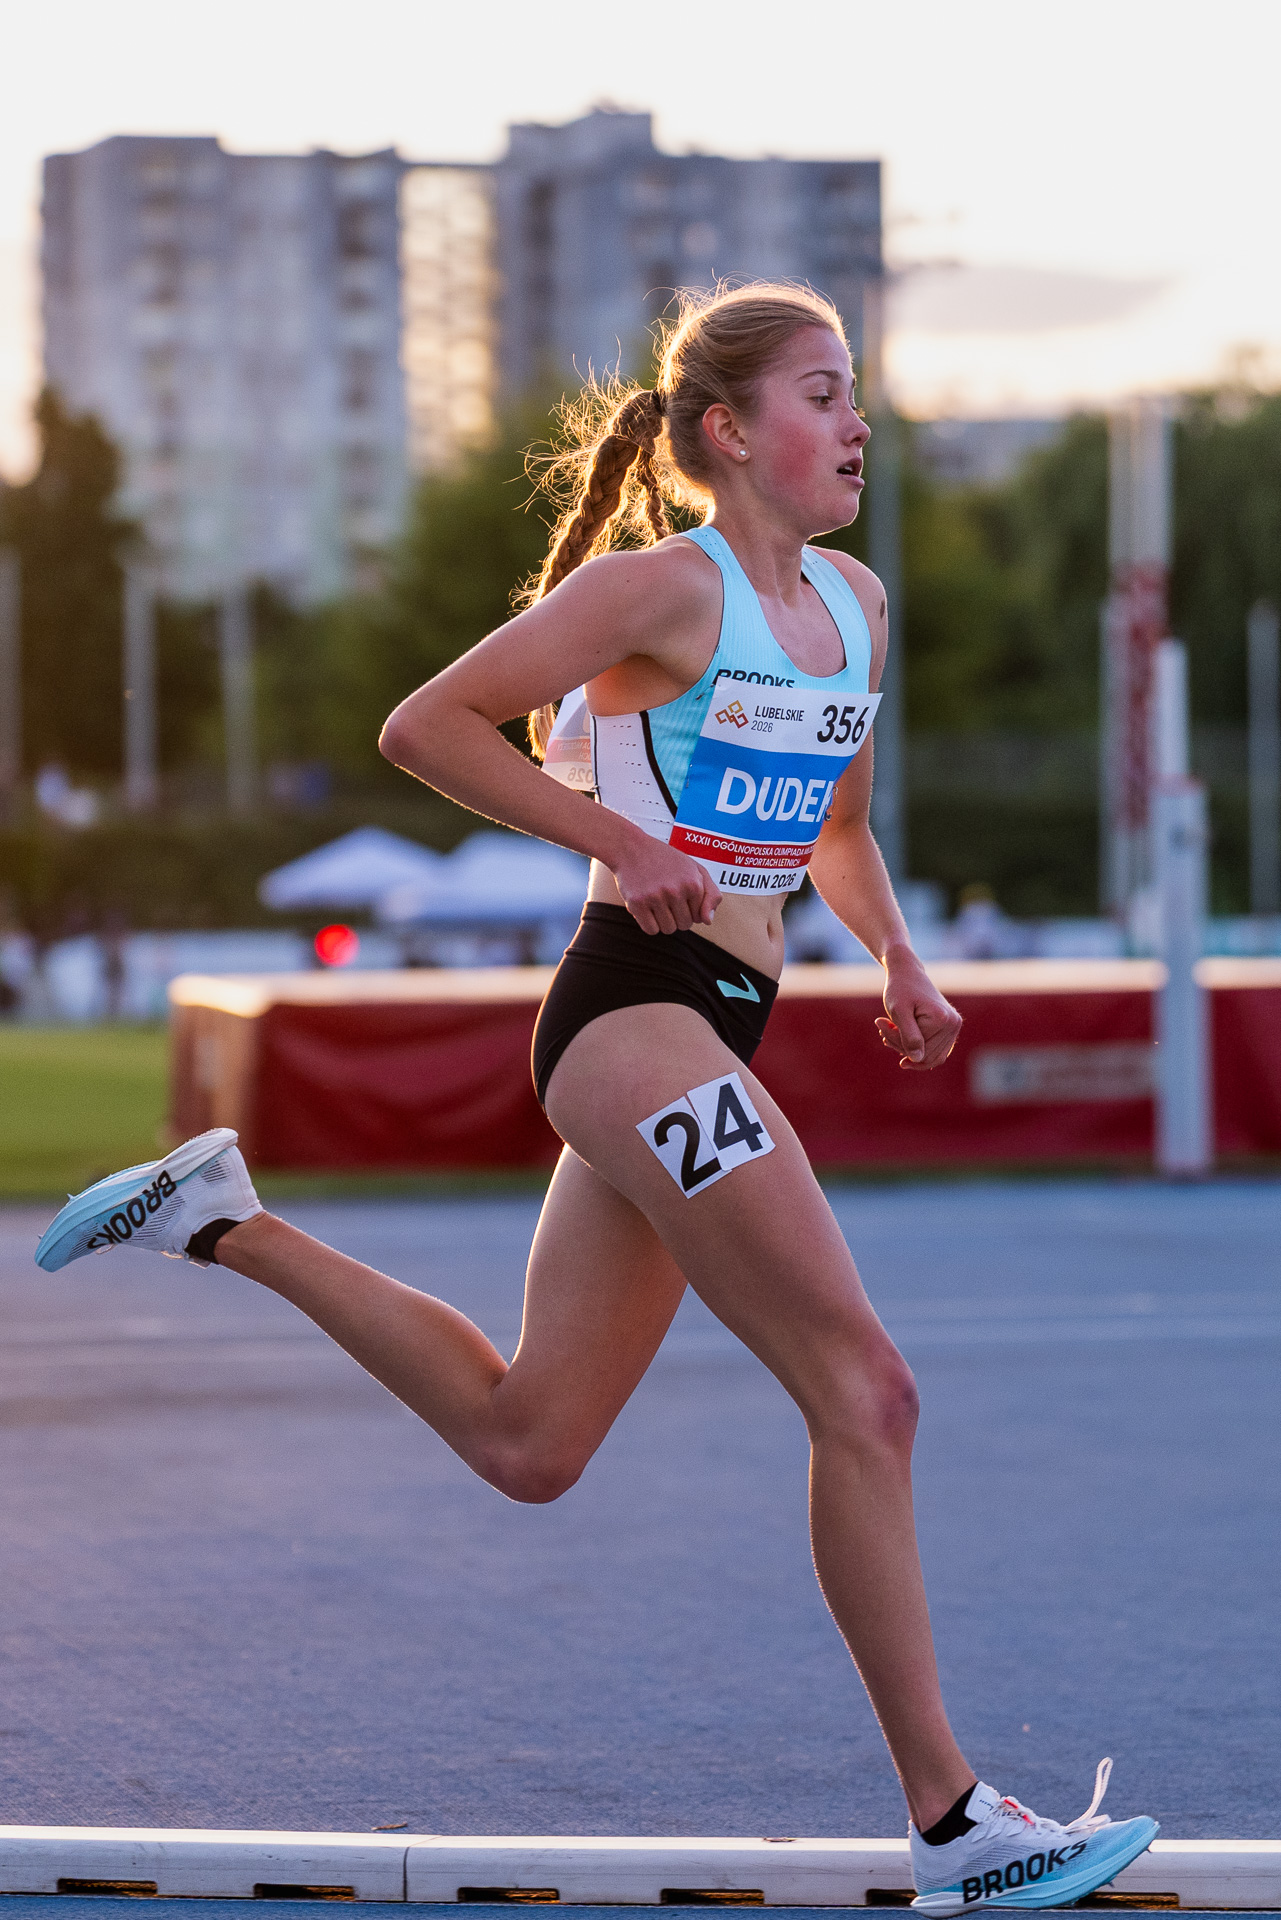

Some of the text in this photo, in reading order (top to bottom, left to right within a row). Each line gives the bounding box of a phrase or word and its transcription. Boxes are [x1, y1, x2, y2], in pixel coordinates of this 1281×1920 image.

[754, 705, 805, 722] LUBELSKIE
[816, 704, 870, 745] 356
[751, 720, 774, 733] 2026
[685, 832, 710, 846] XXXII
[712, 840, 773, 856] OGÓLNOPOLSKA
[774, 847, 805, 857] OLIMPIADA
[734, 855, 801, 867] W SPORTACH LETNICH
[719, 870, 797, 889] LUBLIN 2026
[653, 1082, 764, 1192] 24
[87, 1170, 177, 1250] BROOKS
[962, 1839, 1087, 1904] BROOKS
